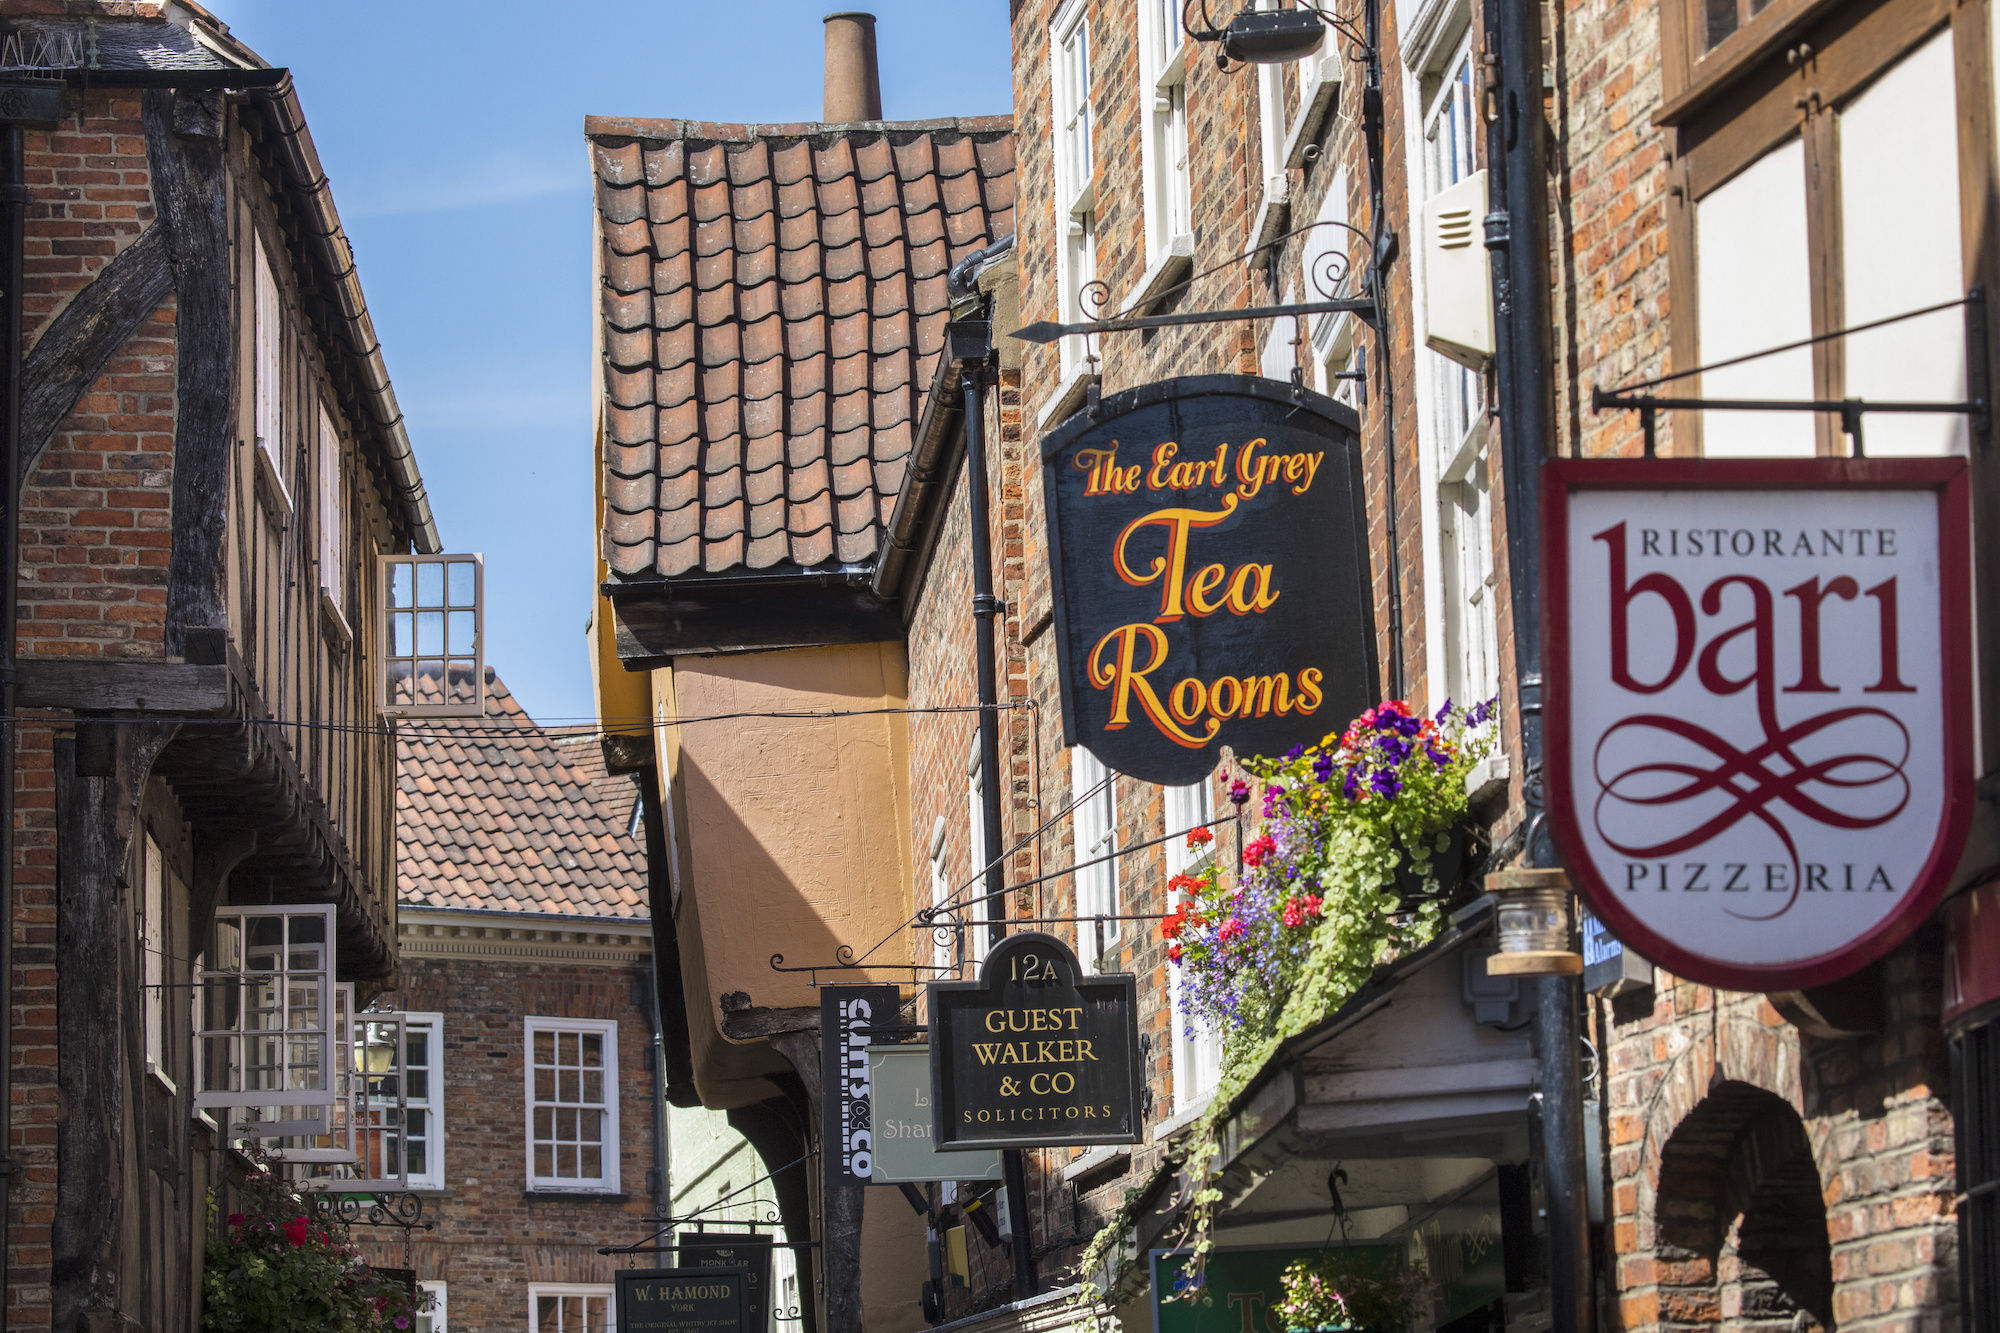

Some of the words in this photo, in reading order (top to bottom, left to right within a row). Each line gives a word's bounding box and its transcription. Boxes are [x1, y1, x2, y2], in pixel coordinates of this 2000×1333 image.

[1072, 439, 1141, 497] The
[1146, 441, 1229, 492] Earl
[1235, 437, 1325, 500] Grey
[1640, 528, 1899, 558] RISTORANTE
[1113, 491, 1281, 624] Tea
[1592, 519, 1918, 697] bari
[1087, 622, 1324, 750] Rooms
[1624, 862, 1897, 893] PIZZERIA
[1010, 953, 1059, 982] 12A
[985, 1007, 1083, 1033] GUEST
[972, 1039, 1100, 1066] WALKER
[999, 1075, 1021, 1097] &
[1029, 1071, 1076, 1095] CO
[963, 1105, 1111, 1123] SOLICITORS
[700, 1258, 727, 1268] MONK
[634, 1284, 654, 1302] W.
[659, 1284, 731, 1300] HAMOND
[671, 1303, 695, 1312] YORK
[706, 1320, 718, 1328] JET
